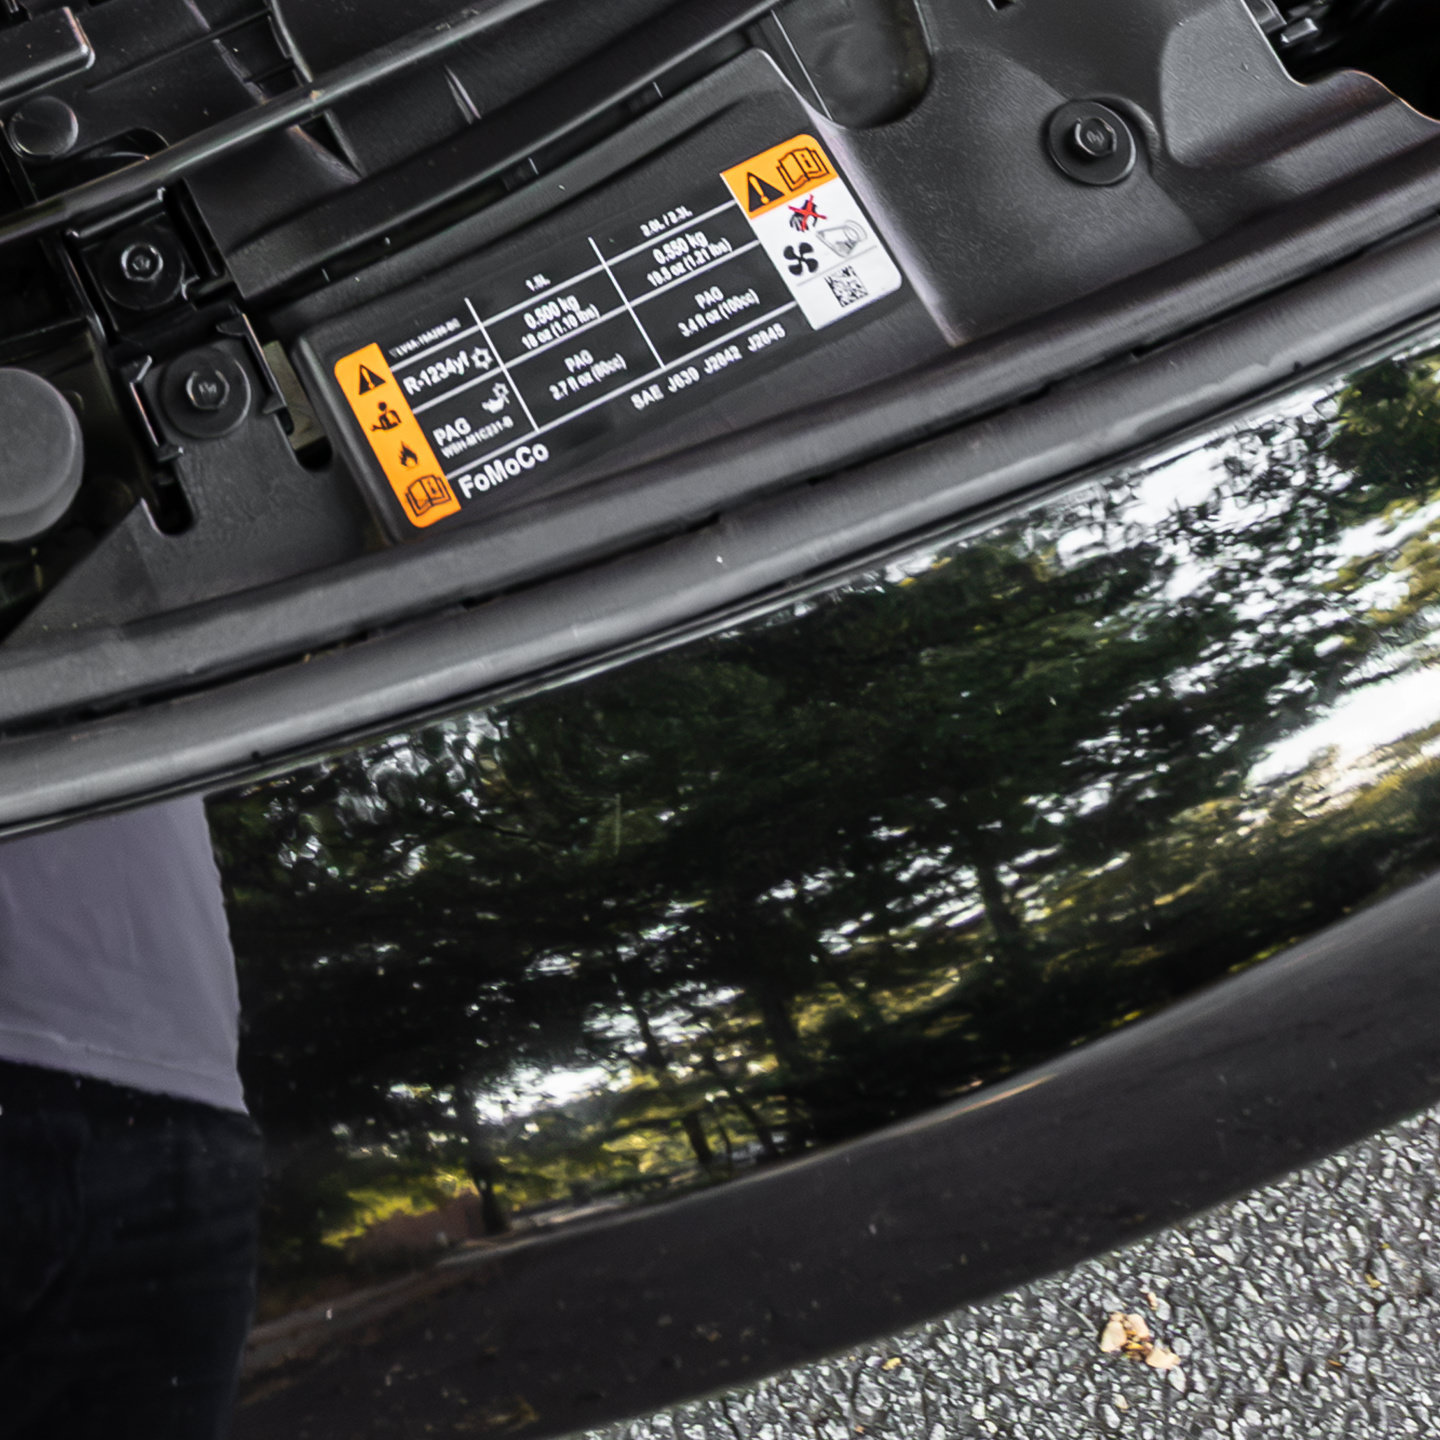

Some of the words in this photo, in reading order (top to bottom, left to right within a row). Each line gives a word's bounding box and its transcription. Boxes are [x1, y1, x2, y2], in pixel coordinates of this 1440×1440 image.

[685, 231, 709, 249] kg
[672, 261, 686, 276] oz
[557, 295, 581, 315] kg
[694, 285, 724, 310] PAG
[706, 308, 722, 325] oz
[537, 328, 553, 343] oz
[564, 349, 594, 373] PAG
[403, 350, 469, 395] R-1234yf
[577, 371, 594, 387] oz
[630, 384, 664, 410] SAE
[432, 417, 471, 446] PAG
[458, 443, 549, 499] FoMoCo
